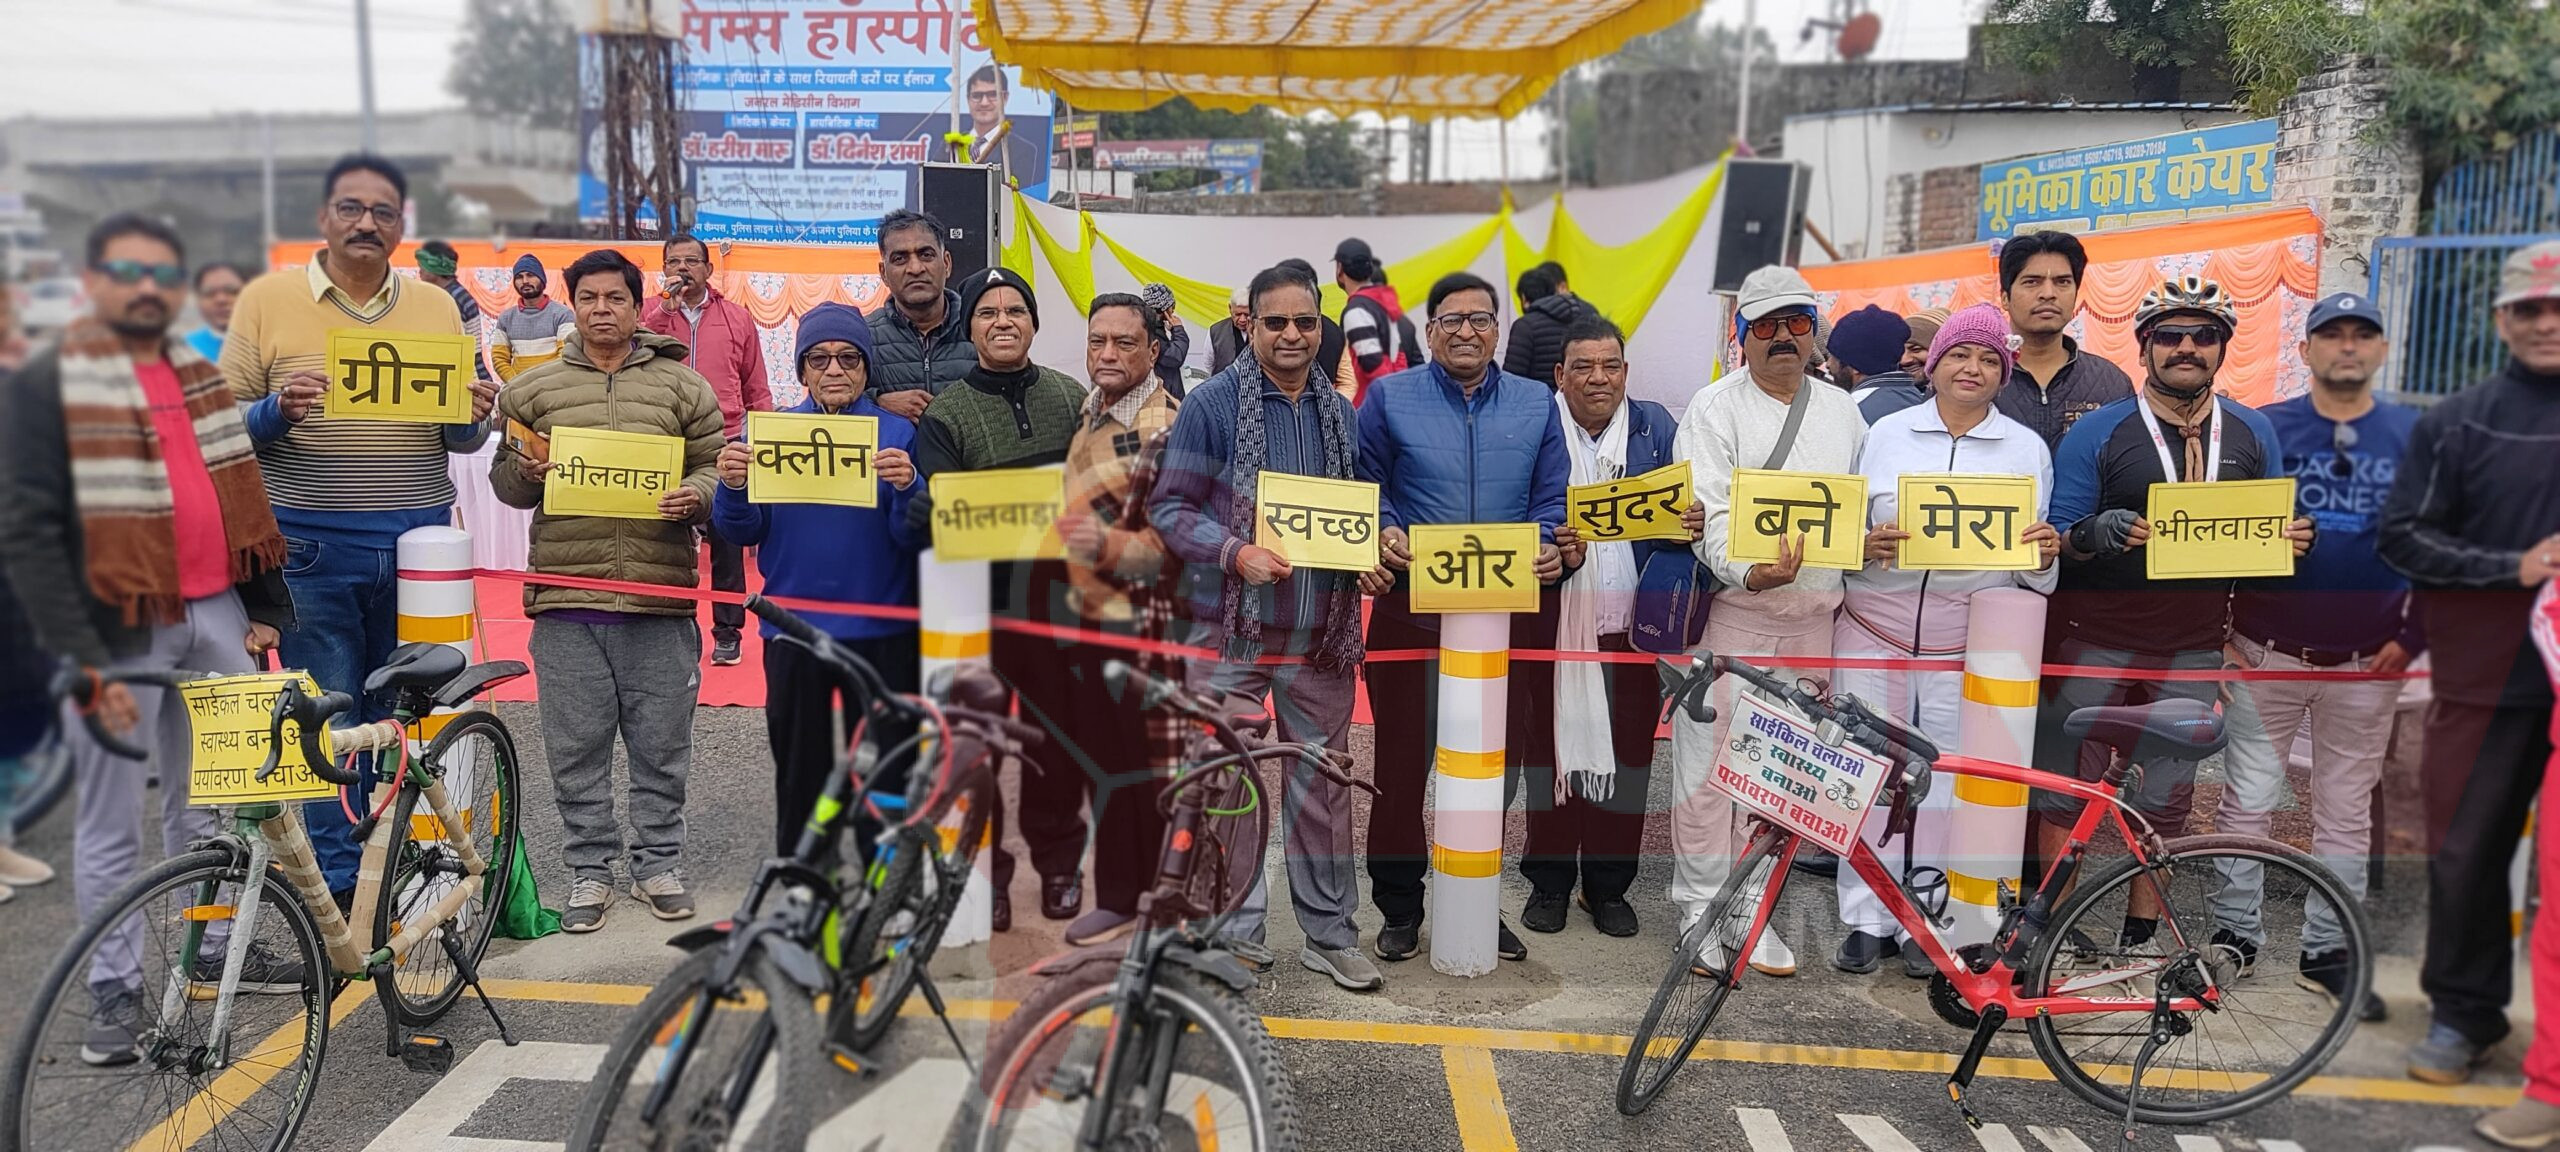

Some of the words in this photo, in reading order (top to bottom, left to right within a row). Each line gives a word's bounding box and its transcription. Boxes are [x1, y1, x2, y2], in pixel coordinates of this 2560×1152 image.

[774, 69, 786, 84] के
[790, 73, 811, 84] साथ
[815, 69, 857, 85] रियायती
[861, 69, 880, 85] दरों
[884, 74, 899, 85] पर
[903, 70, 935, 87] ईलाज
[744, 96, 778, 108] जनरल
[827, 93, 861, 109] विभाग
[889, 134, 928, 163] शर्मा
[1983, 167, 2086, 233] भूमिका
[2089, 158, 2161, 207] कार
[2167, 137, 2277, 200] केयर
[863, 224, 871, 236] के
[338, 341, 456, 406] ग्रीन
[754, 427, 873, 479] क्लीन
[554, 455, 670, 494] भीलवाड़ा
[936, 498, 1058, 536] भीलवाड़ा
[1576, 481, 1684, 536] सुंदर
[1753, 480, 1841, 549] बने
[1919, 484, 2020, 551] मेरा
[2299, 483, 2390, 514] ONES
[1264, 501, 1375, 546] स्वच्छ
[2155, 509, 2287, 547] भीलवाड़ा
[1426, 534, 1517, 588] और
[190, 688, 240, 717] साईकल
[1749, 711, 1811, 753] साईकिल
[1811, 742, 1866, 778] चलाओ
[1769, 744, 1829, 783] स्वास्थ्य
[194, 761, 248, 791] पर्यावरण
[1760, 765, 1819, 804] बनाओ
[1717, 764, 1788, 815] पर्यावरण
[1788, 803, 1851, 846] बचाओ
[305, 1015, 319, 1069] NINETY
[294, 1070, 310, 1105] ONE
